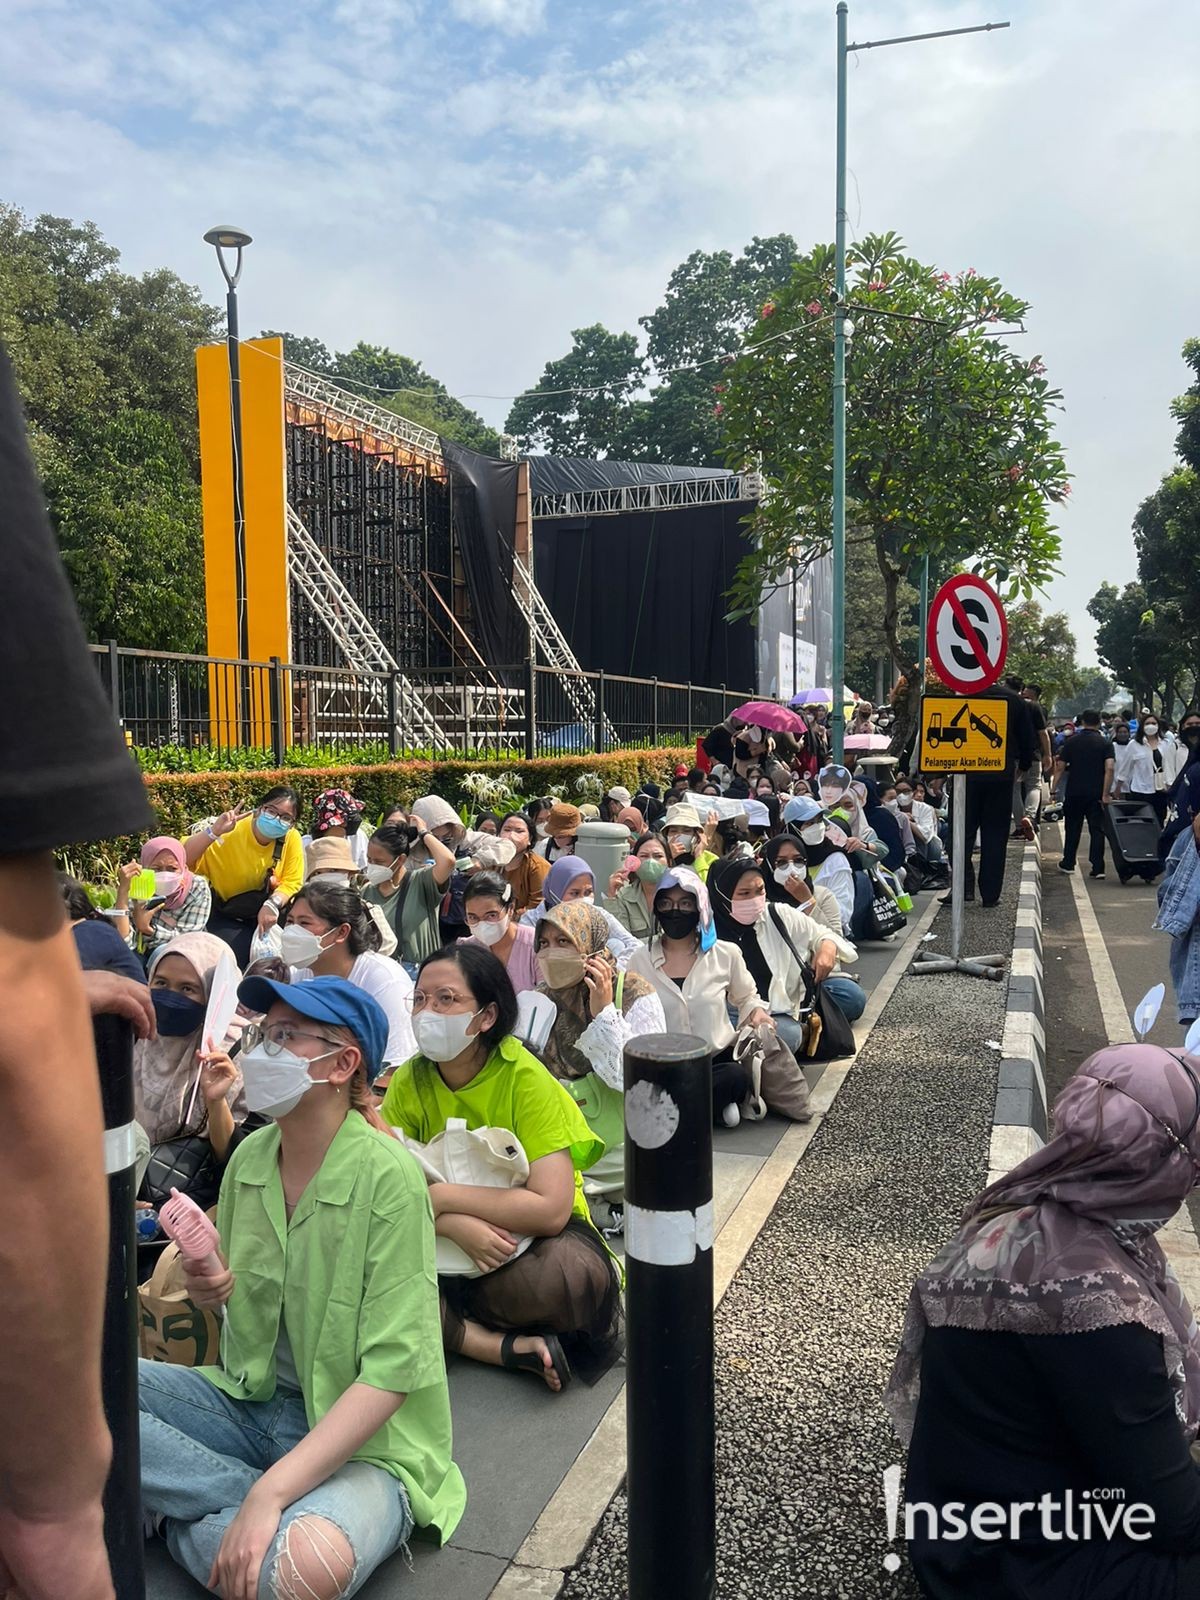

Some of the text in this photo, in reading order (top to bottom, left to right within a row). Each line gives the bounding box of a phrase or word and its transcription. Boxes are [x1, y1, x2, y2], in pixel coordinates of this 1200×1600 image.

[951, 598, 989, 670] S
[925, 757, 1002, 769] Pelanggar Akan Diderek
